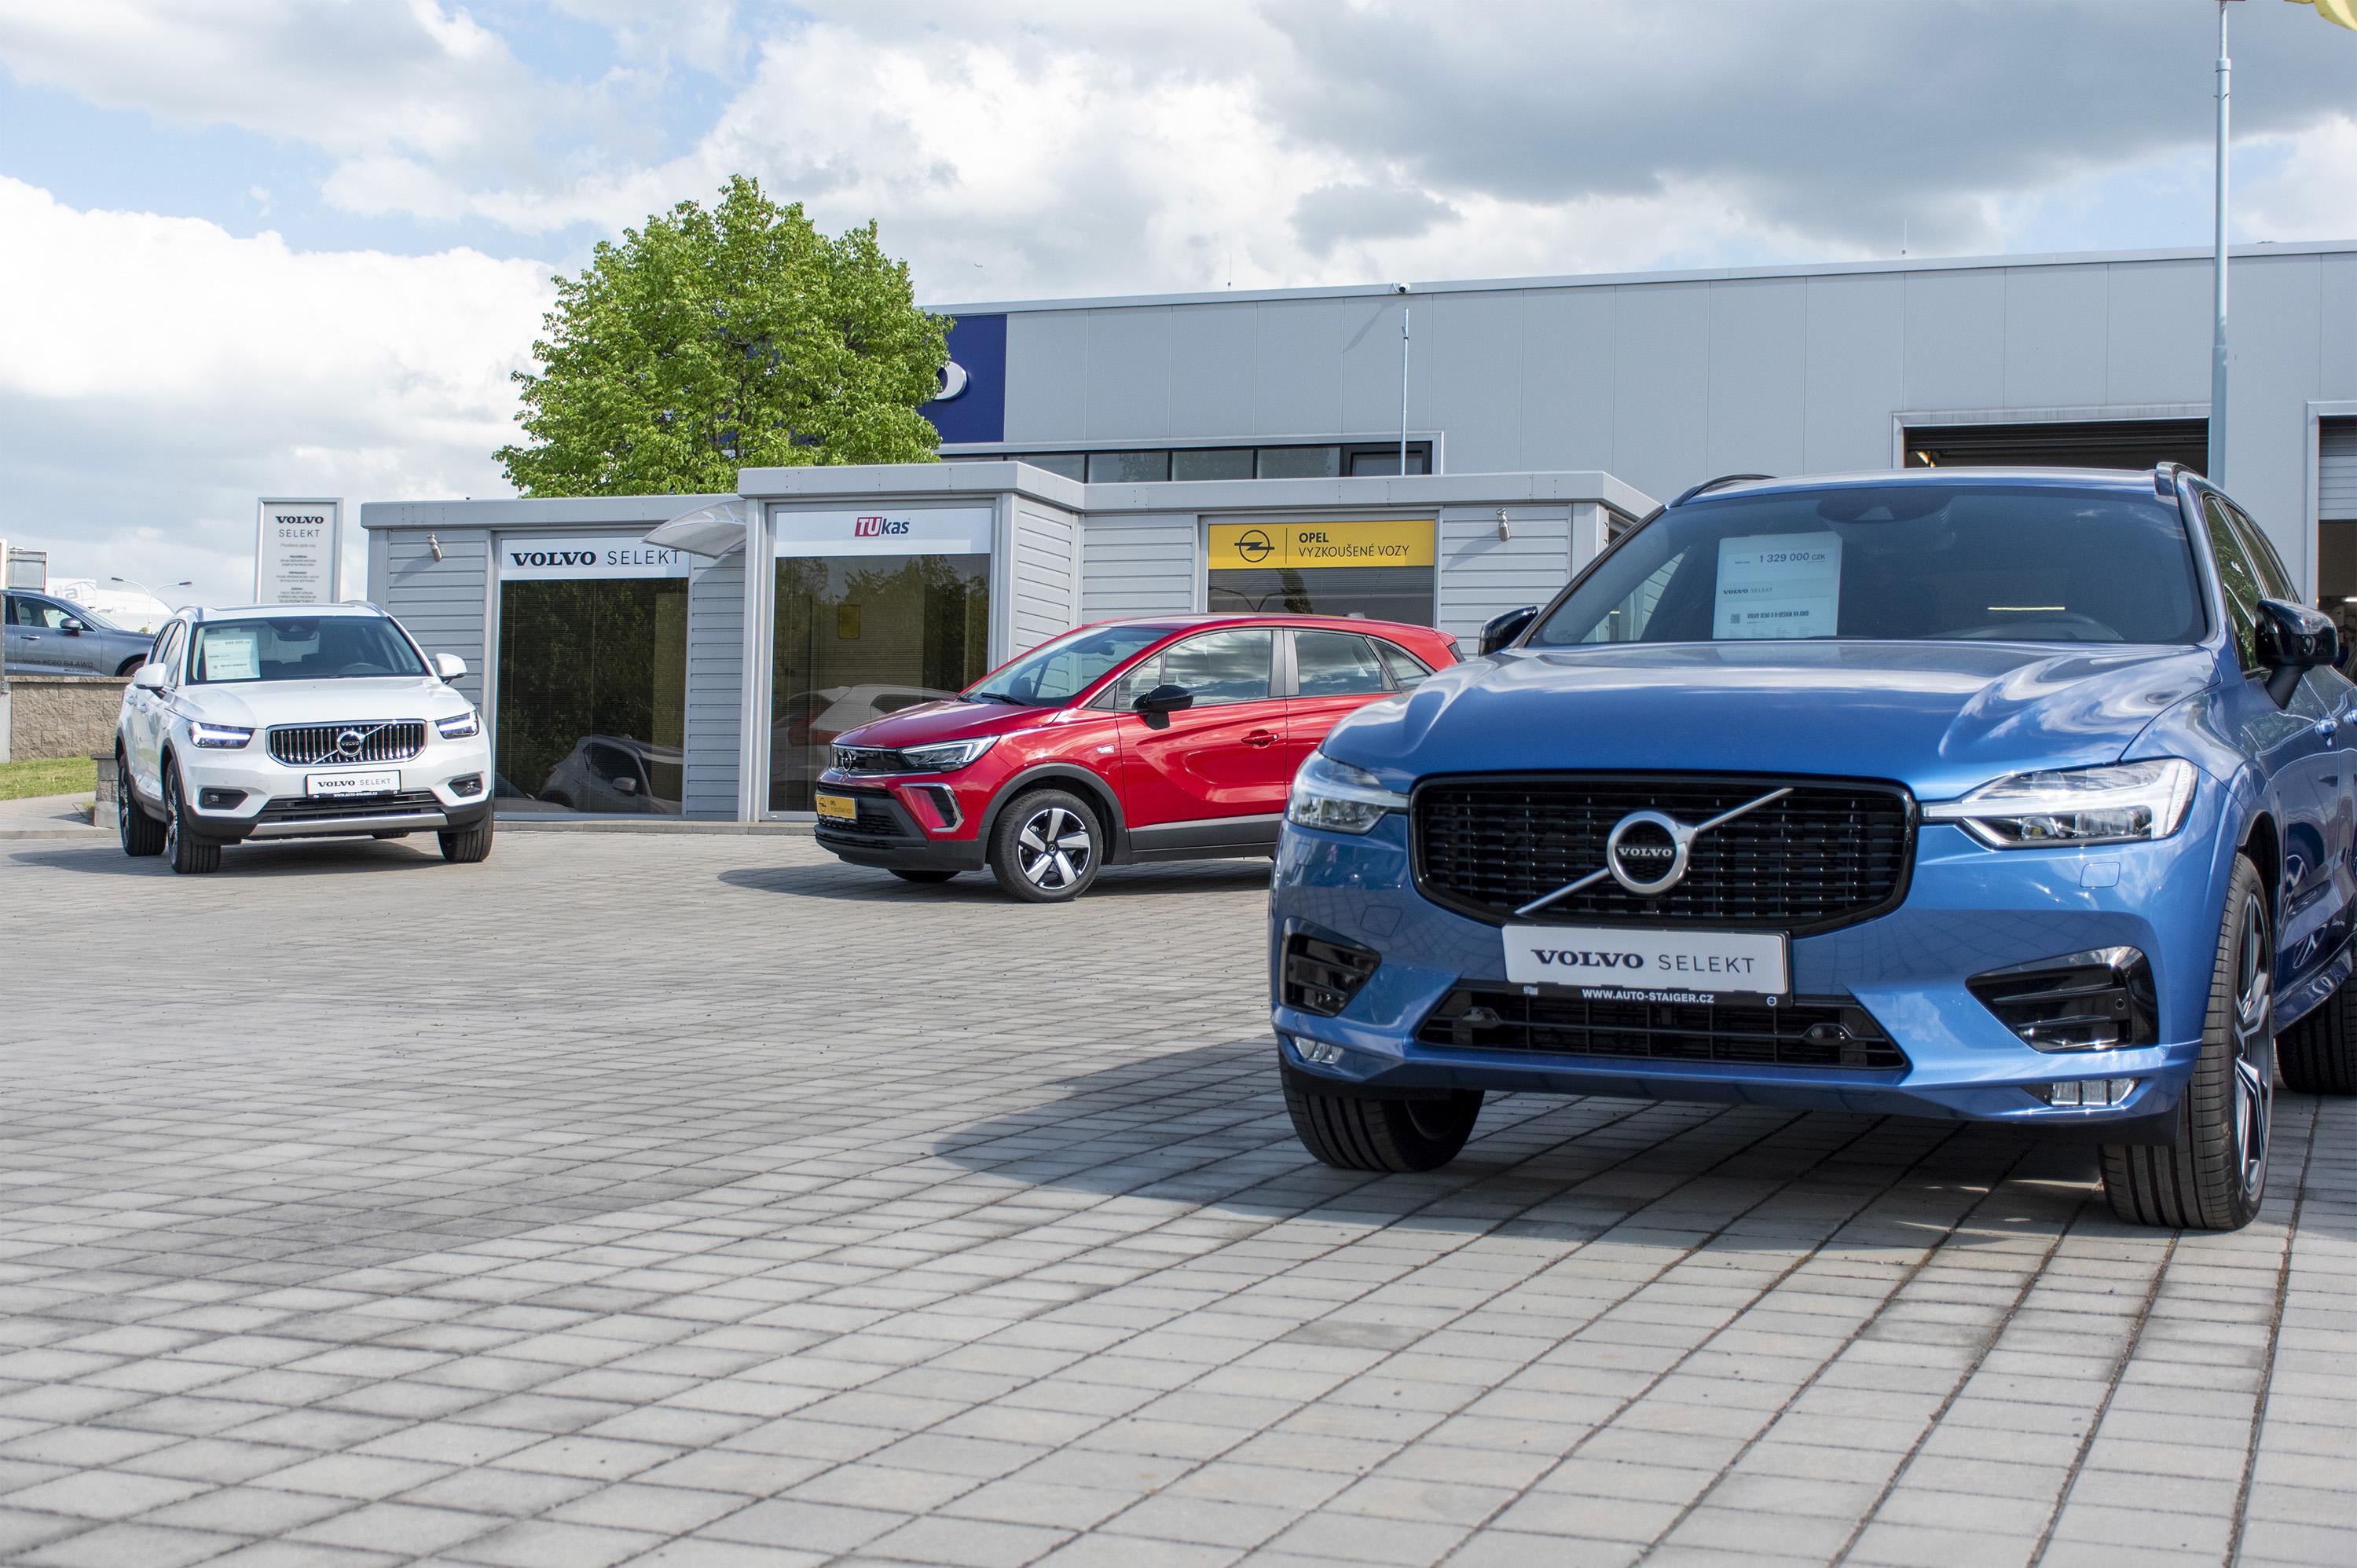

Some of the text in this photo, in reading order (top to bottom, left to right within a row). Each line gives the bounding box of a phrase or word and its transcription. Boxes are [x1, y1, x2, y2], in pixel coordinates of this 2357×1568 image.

[275, 515, 324, 524] VOLVO
[856, 517, 910, 537] TUkas
[278, 529, 321, 538] SELEKT
[1299, 532, 1329, 543] OPEL
[1298, 543, 1410, 558] VYZKOUŠENÉ VOZY
[511, 550, 679, 566] VOLVO SELEKT
[1759, 555, 1764, 563] 1
[1767, 554, 1787, 562] 329
[1790, 552, 1809, 562] 000
[359, 778, 391, 786] SELEKT
[1618, 848, 1673, 857] VOLVO
[1530, 949, 1754, 974] VOLVO SELEKT
[1582, 988, 1715, 1004] WWW.AUTO-STAIGER.CZ
